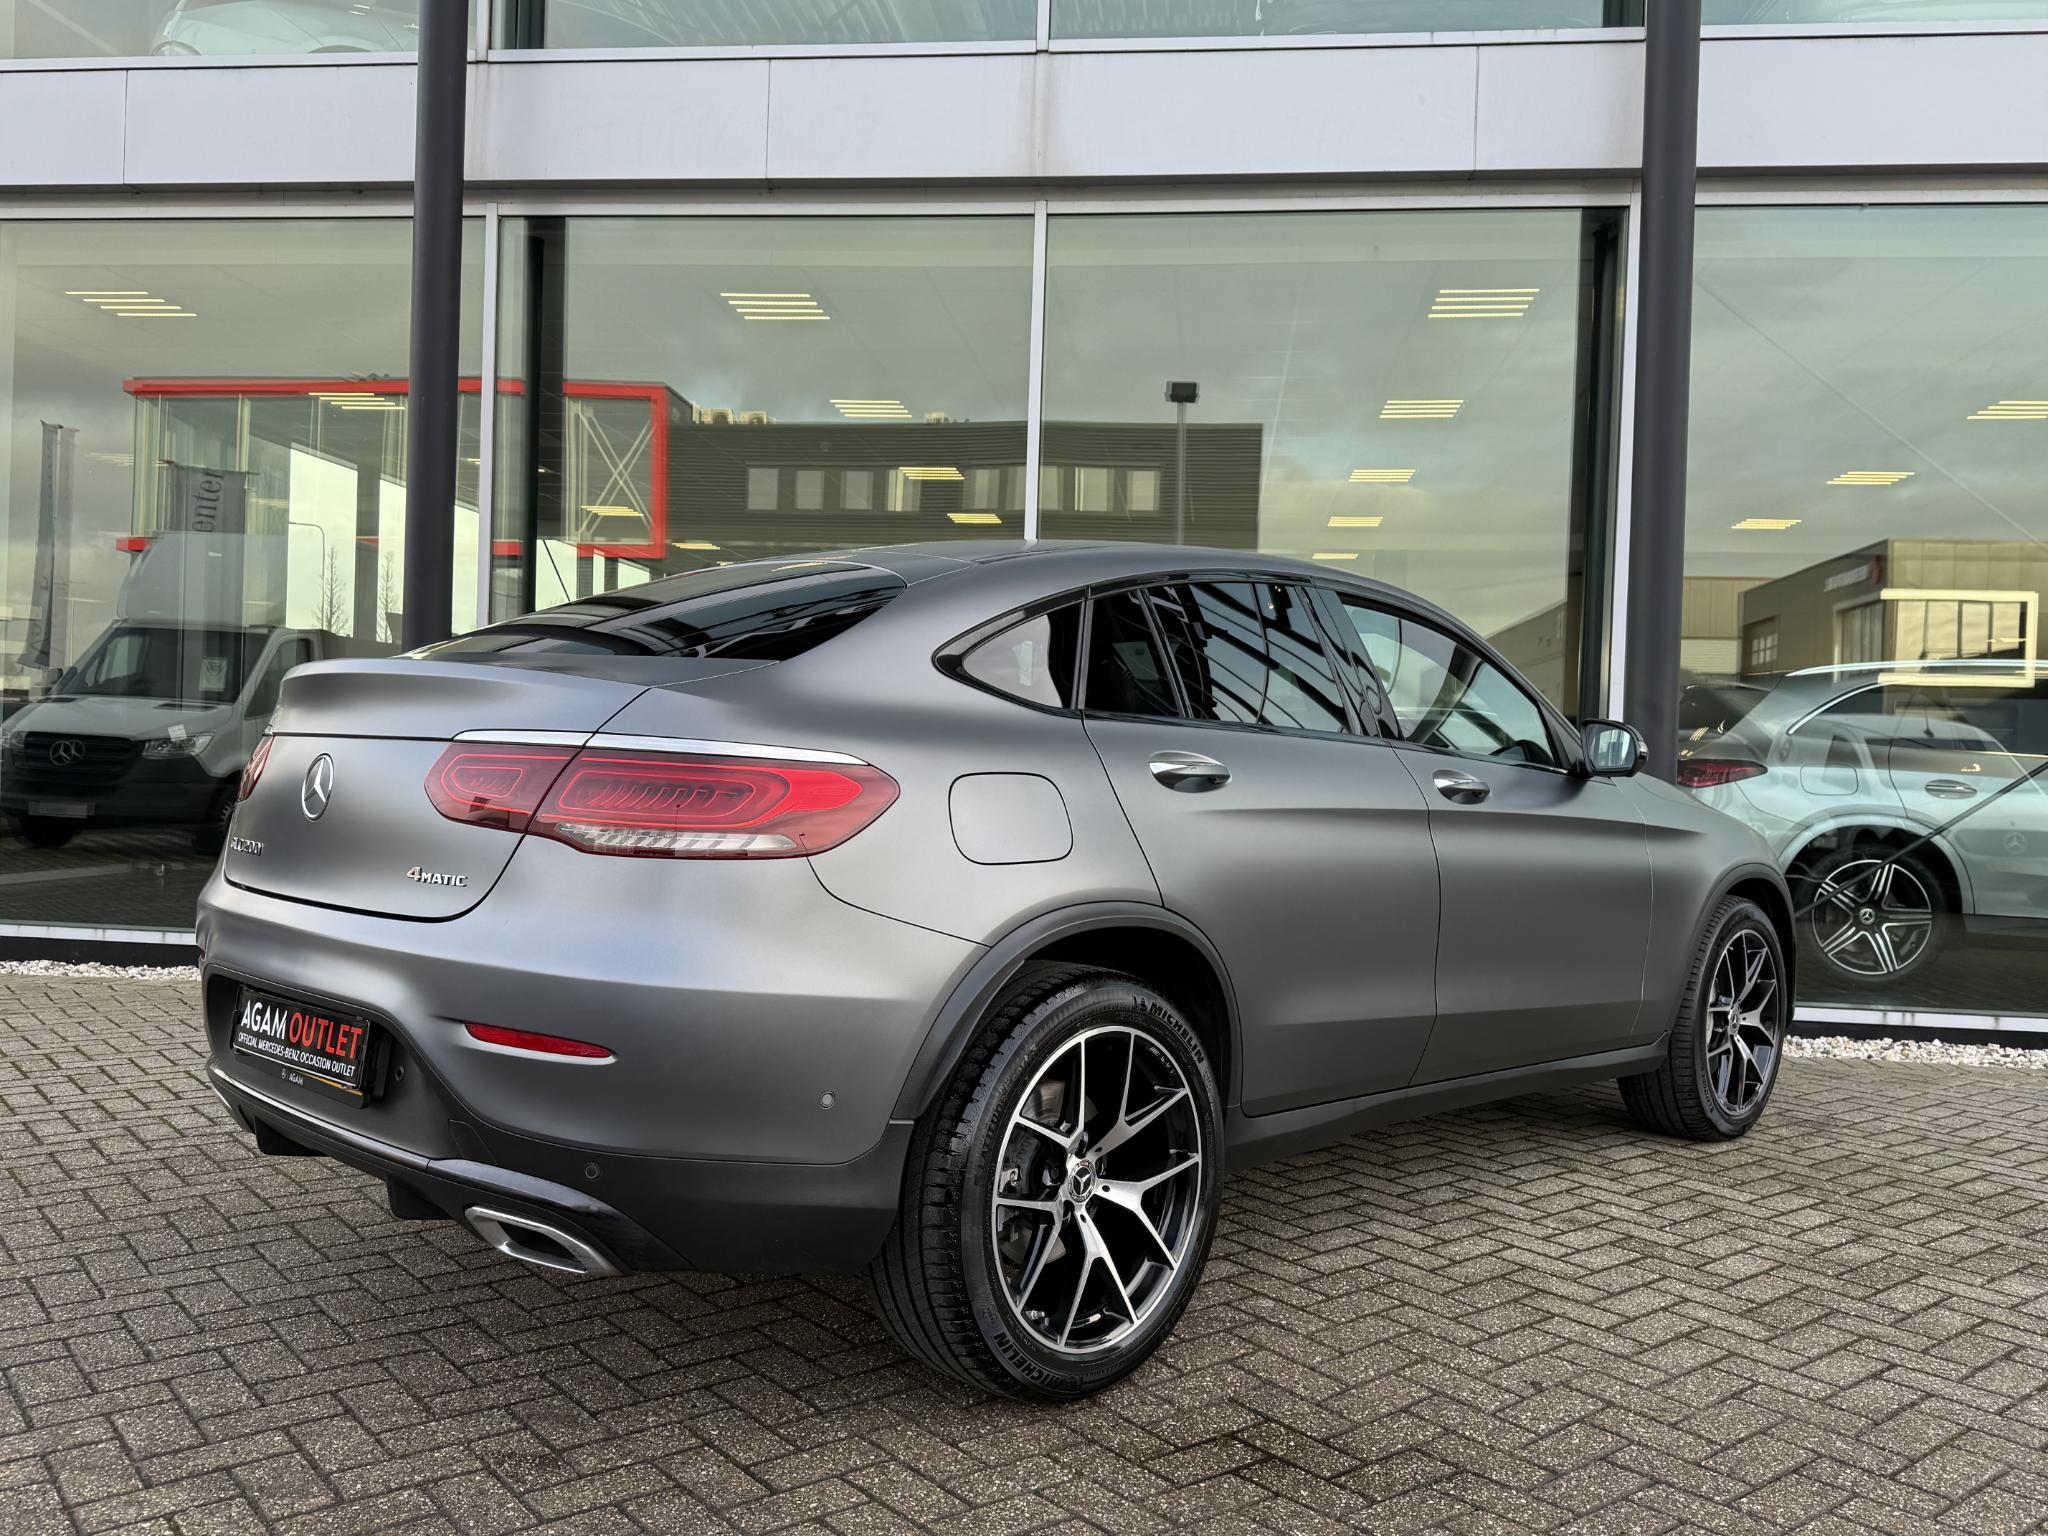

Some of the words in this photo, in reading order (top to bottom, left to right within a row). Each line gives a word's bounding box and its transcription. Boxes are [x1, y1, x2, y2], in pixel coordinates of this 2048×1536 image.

[406, 866, 468, 887] 4MATIC
[238, 1032, 258, 1048] OFFICIAL
[258, 1038, 299, 1061] MERCEDES-BENZ
[300, 1051, 331, 1070] OCCASION
[331, 1060, 356, 1077] OUTLET
[240, 999, 288, 1040] AGAM
[289, 1011, 363, 1059] OUTLET
[1149, 1001, 1205, 1065] MICHELIN
